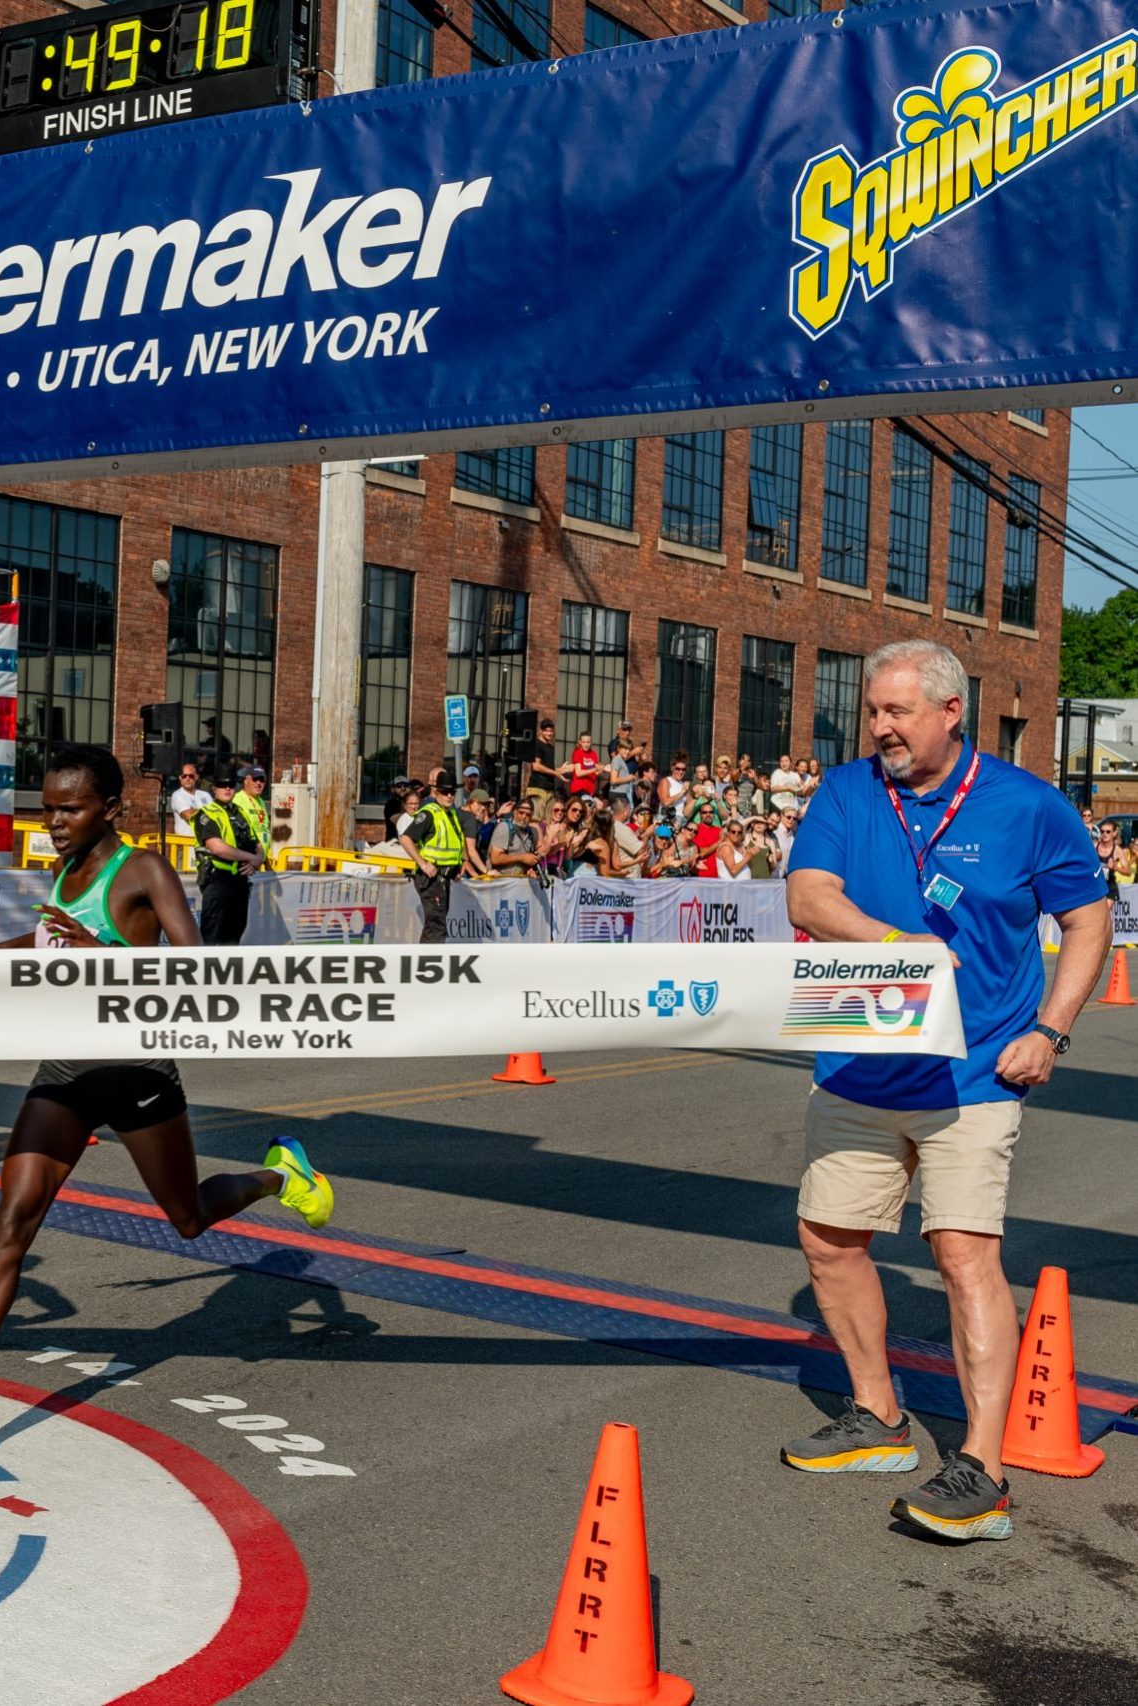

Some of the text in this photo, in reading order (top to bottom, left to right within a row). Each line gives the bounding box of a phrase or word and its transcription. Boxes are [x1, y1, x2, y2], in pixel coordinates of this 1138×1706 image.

[43, 88, 193, 140] FINISH LINE
[37, 339, 174, 393] UTICA,
[184, 323, 295, 377] NEW
[303, 307, 441, 365] YORK
[579, 887, 636, 907] Boilermaker
[704, 902, 738, 926] UTICA
[10, 955, 481, 987] BOILERMAKER 15K
[792, 958, 934, 980] Boilermaker
[97, 993, 395, 1023] ROAD RACE
[522, 990, 641, 1018] Excellus
[140, 1029, 353, 1053] Utica, New York
[1025, 1314, 1057, 1431] FLRRT
[170, 1394, 357, 1478] 2024
[574, 1485, 619, 1653] FLRRT
